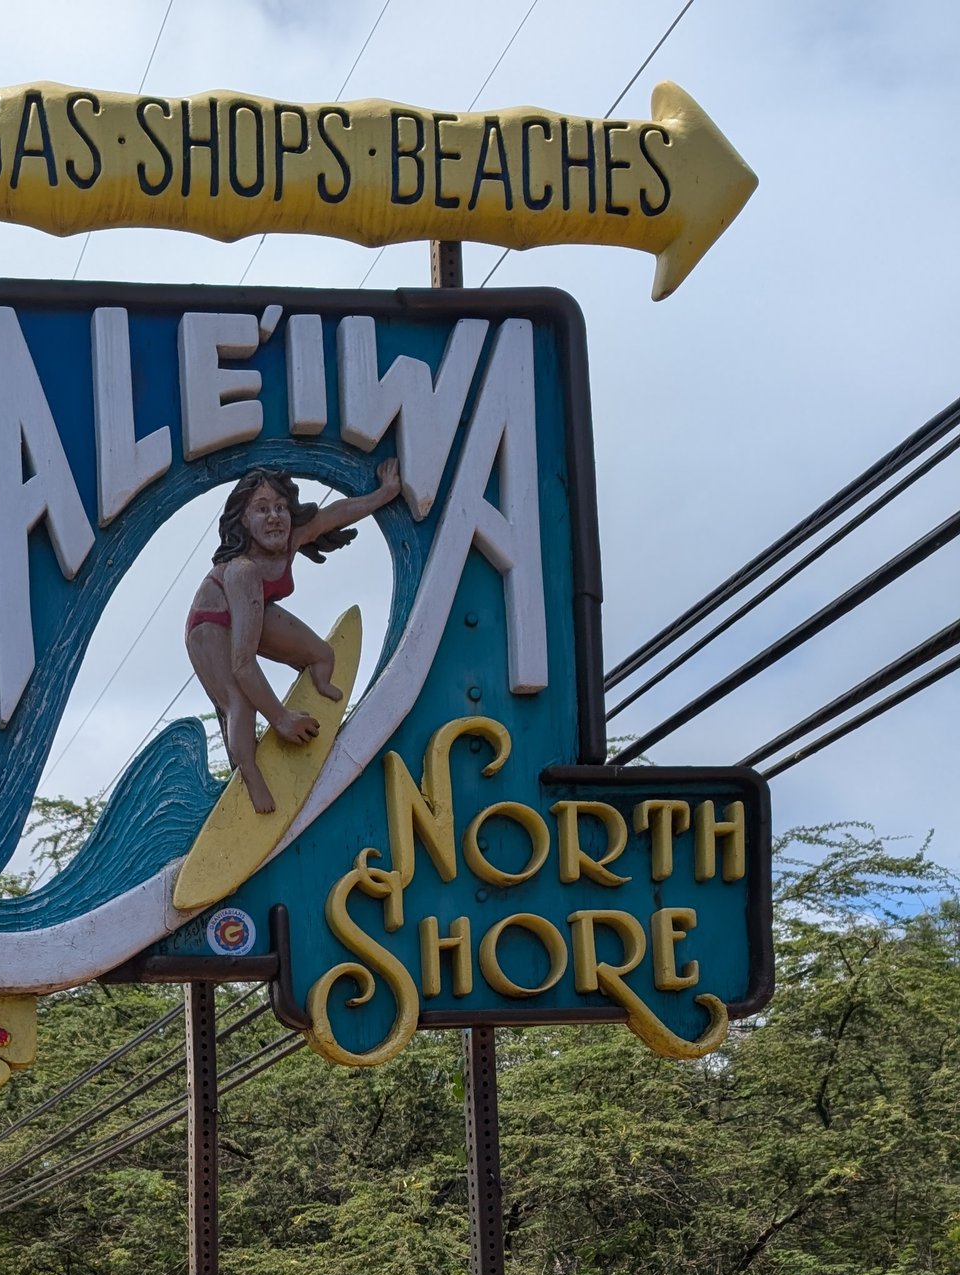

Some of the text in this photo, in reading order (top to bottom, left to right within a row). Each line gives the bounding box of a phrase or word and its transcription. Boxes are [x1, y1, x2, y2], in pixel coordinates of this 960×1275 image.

[136, 95, 351, 204] SHOPS
[390, 107, 672, 217] BEACHES
[382, 715, 746, 890] NORTH
[305, 848, 730, 1067] SHORE
